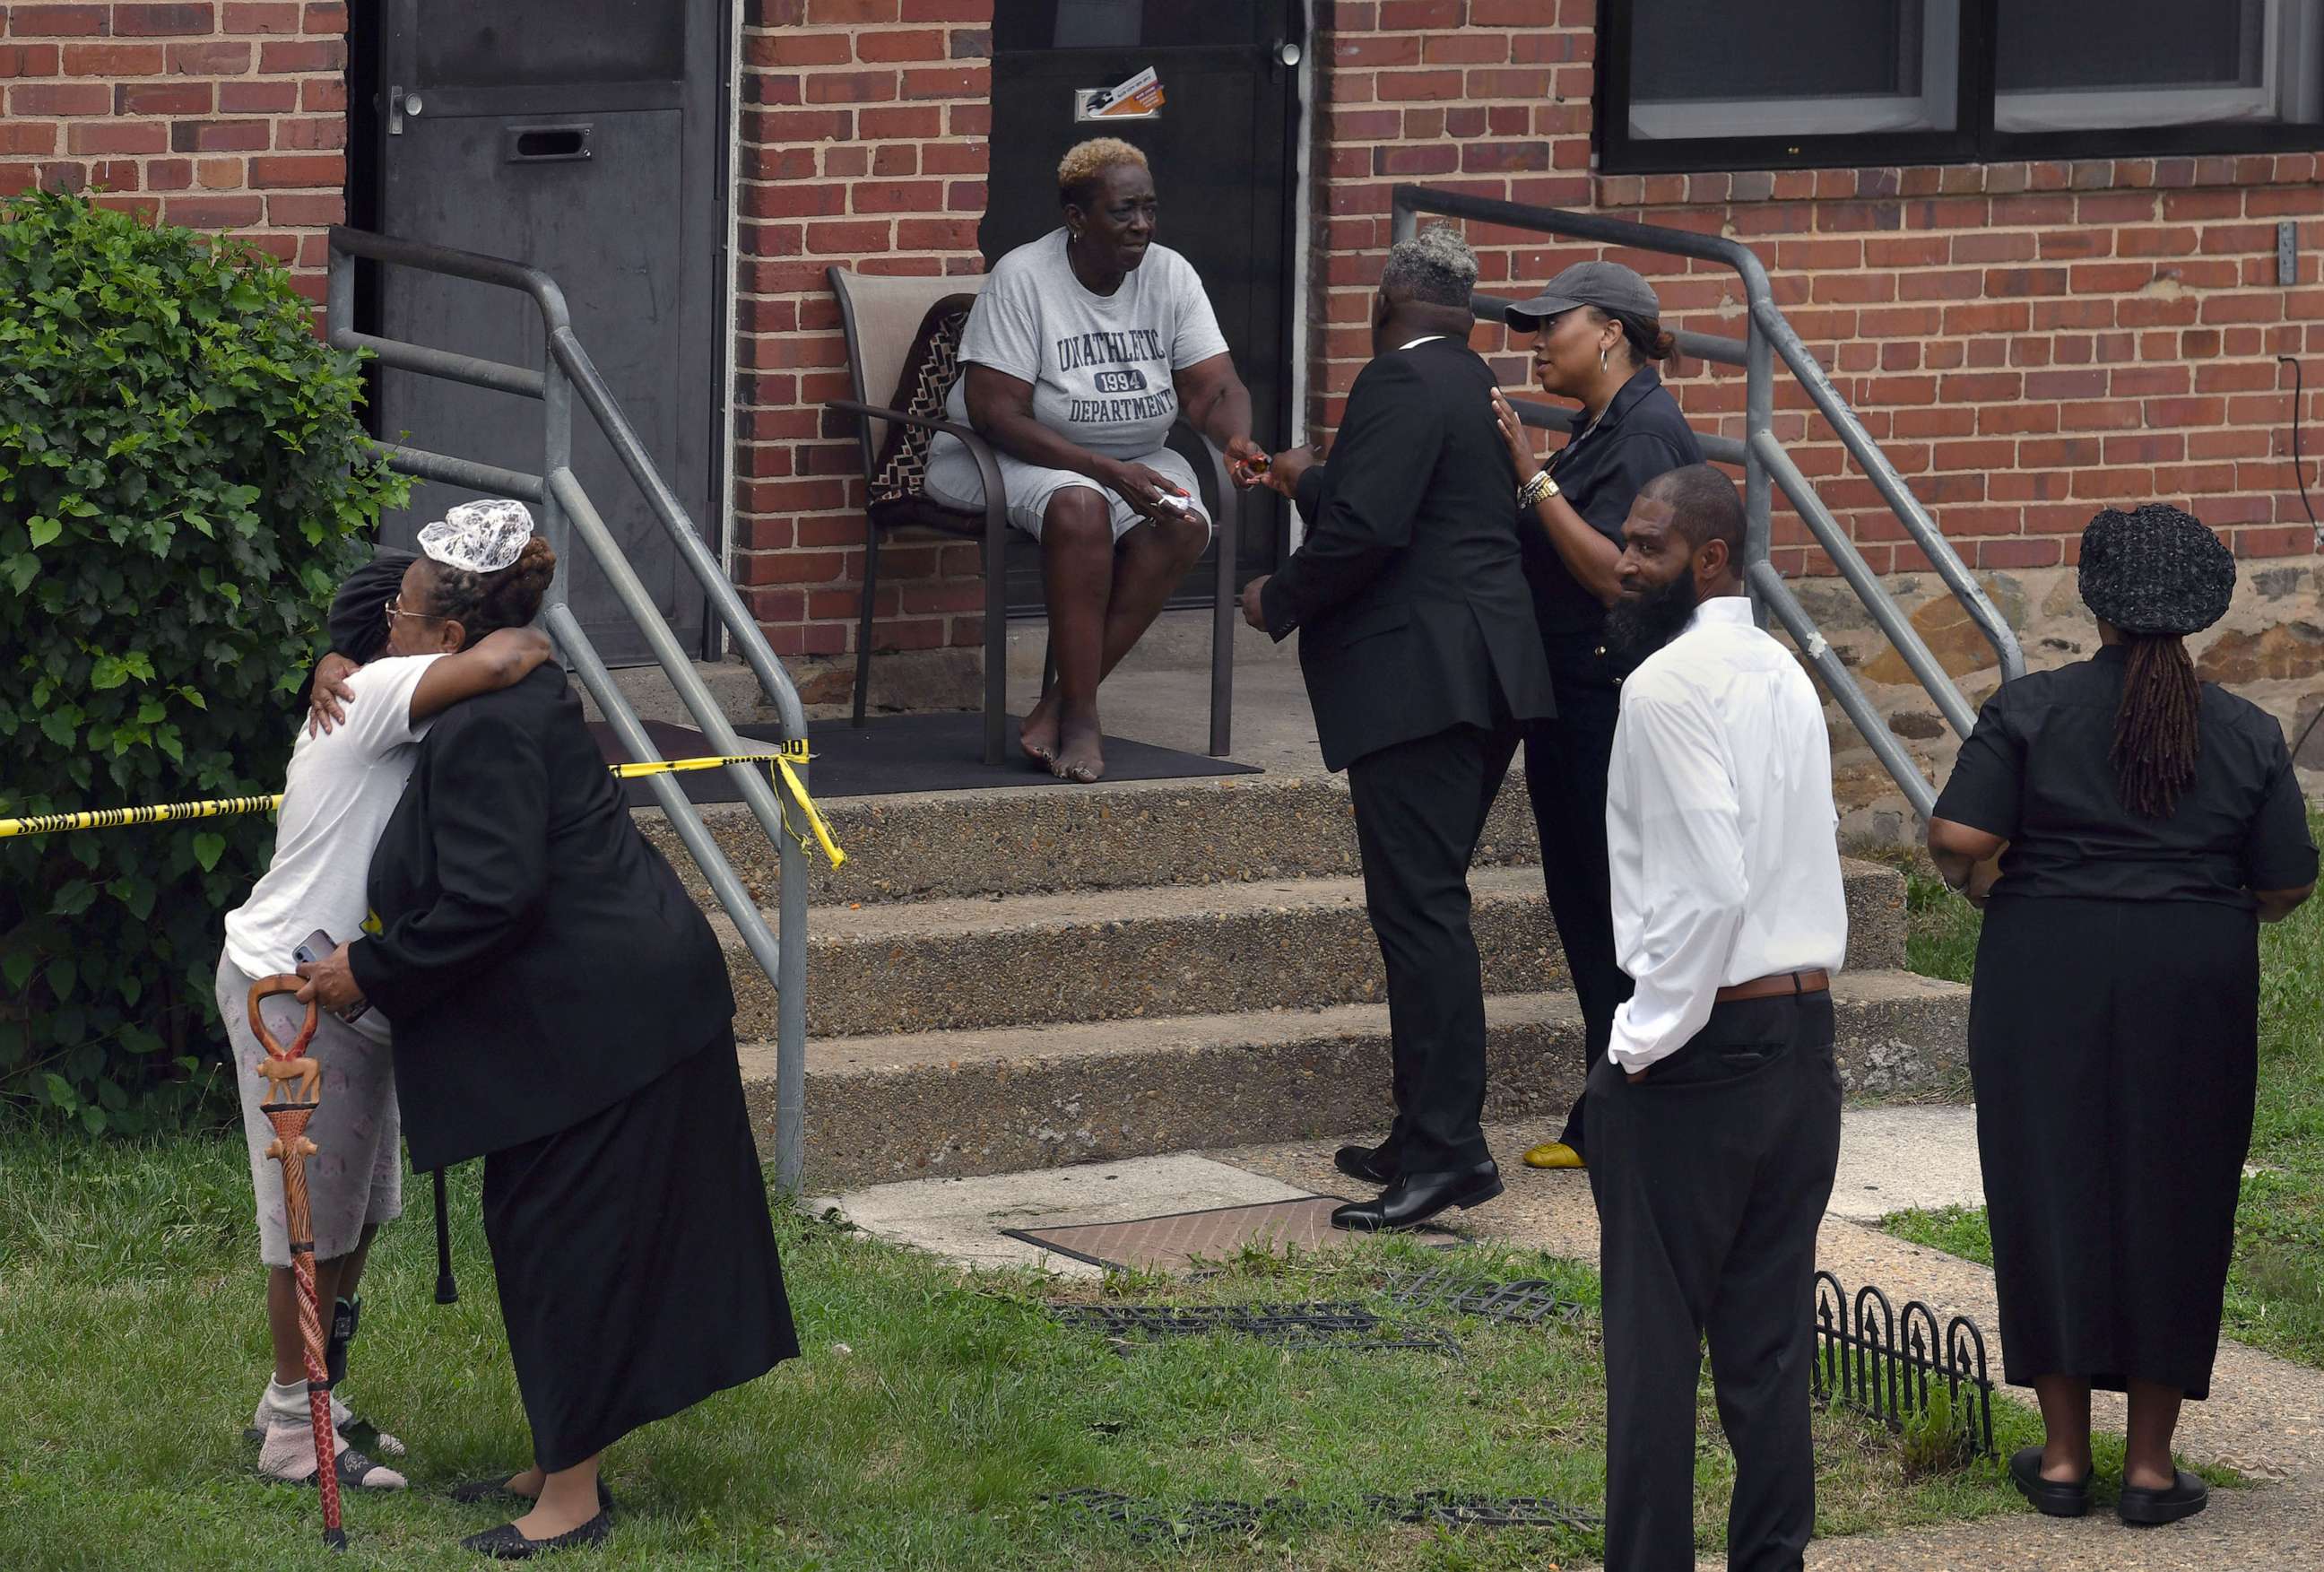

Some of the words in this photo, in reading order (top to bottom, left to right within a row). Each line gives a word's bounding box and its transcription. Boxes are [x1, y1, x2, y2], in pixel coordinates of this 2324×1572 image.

[1057, 329, 1165, 371] UNATHLETIC
[1100, 372, 1140, 391] 1994
[1069, 389, 1174, 422] DEPARTMENT
